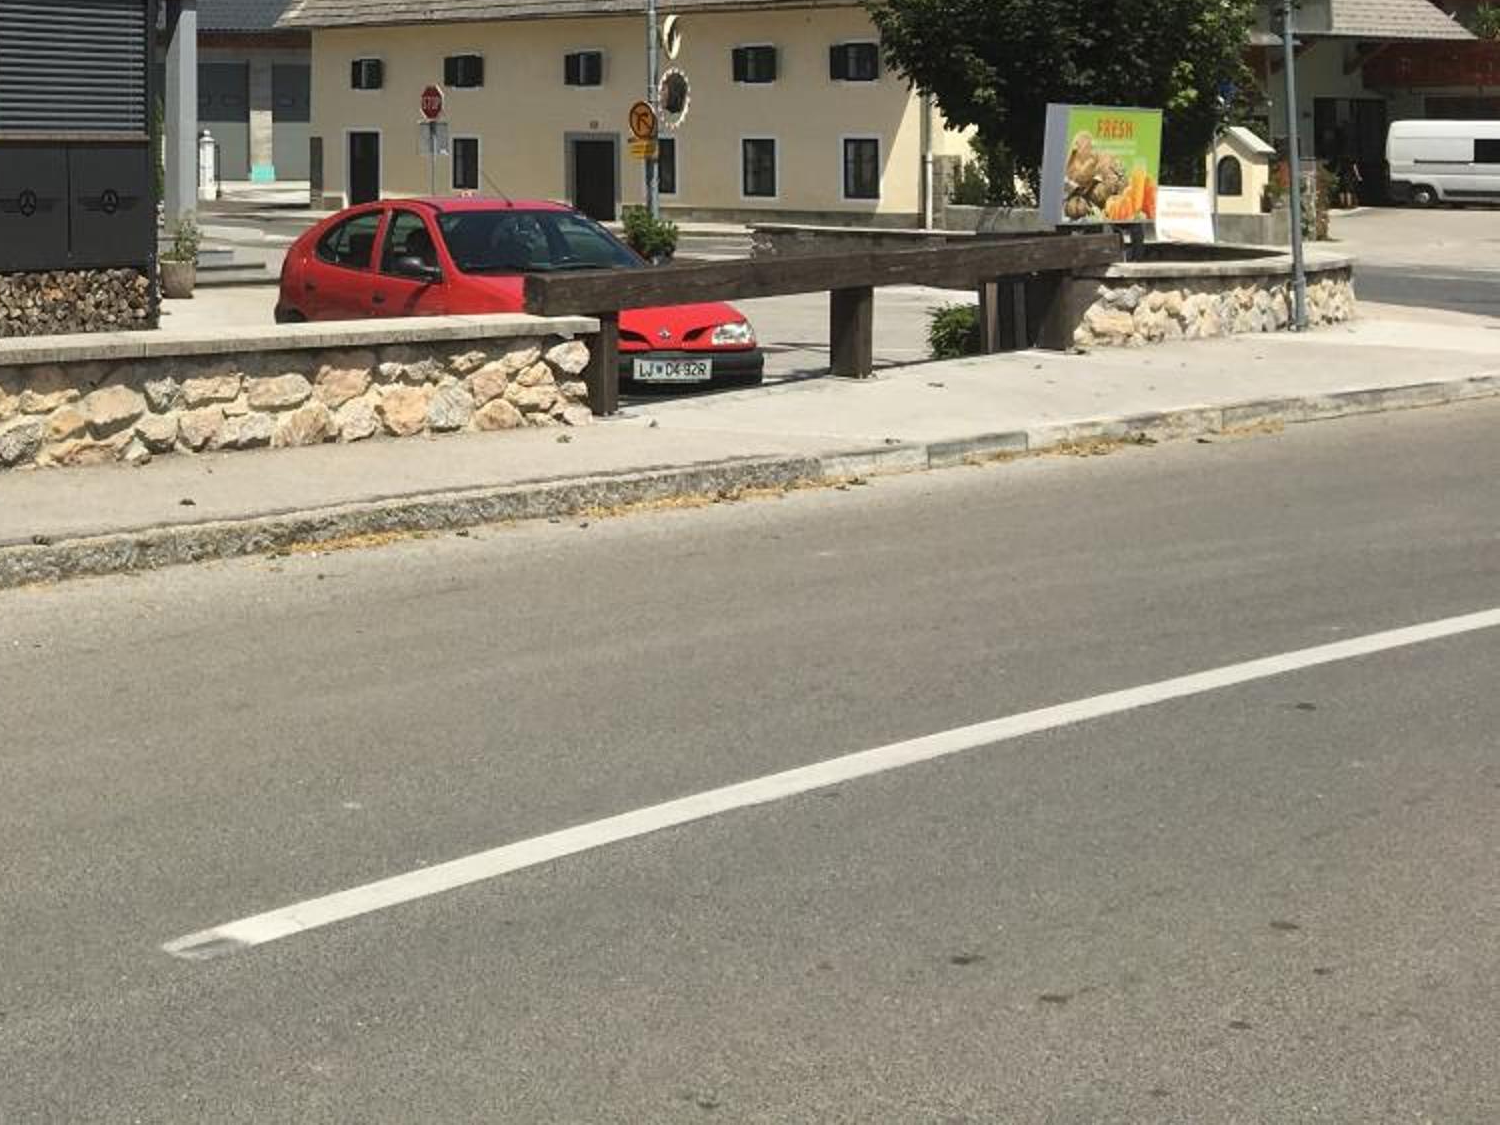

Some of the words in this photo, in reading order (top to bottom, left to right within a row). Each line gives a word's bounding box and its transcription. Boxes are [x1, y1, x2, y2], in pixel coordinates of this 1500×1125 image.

[423, 95, 442, 110] STOP
[1095, 117, 1135, 140] FRESH
[639, 362, 655, 377] LJ
